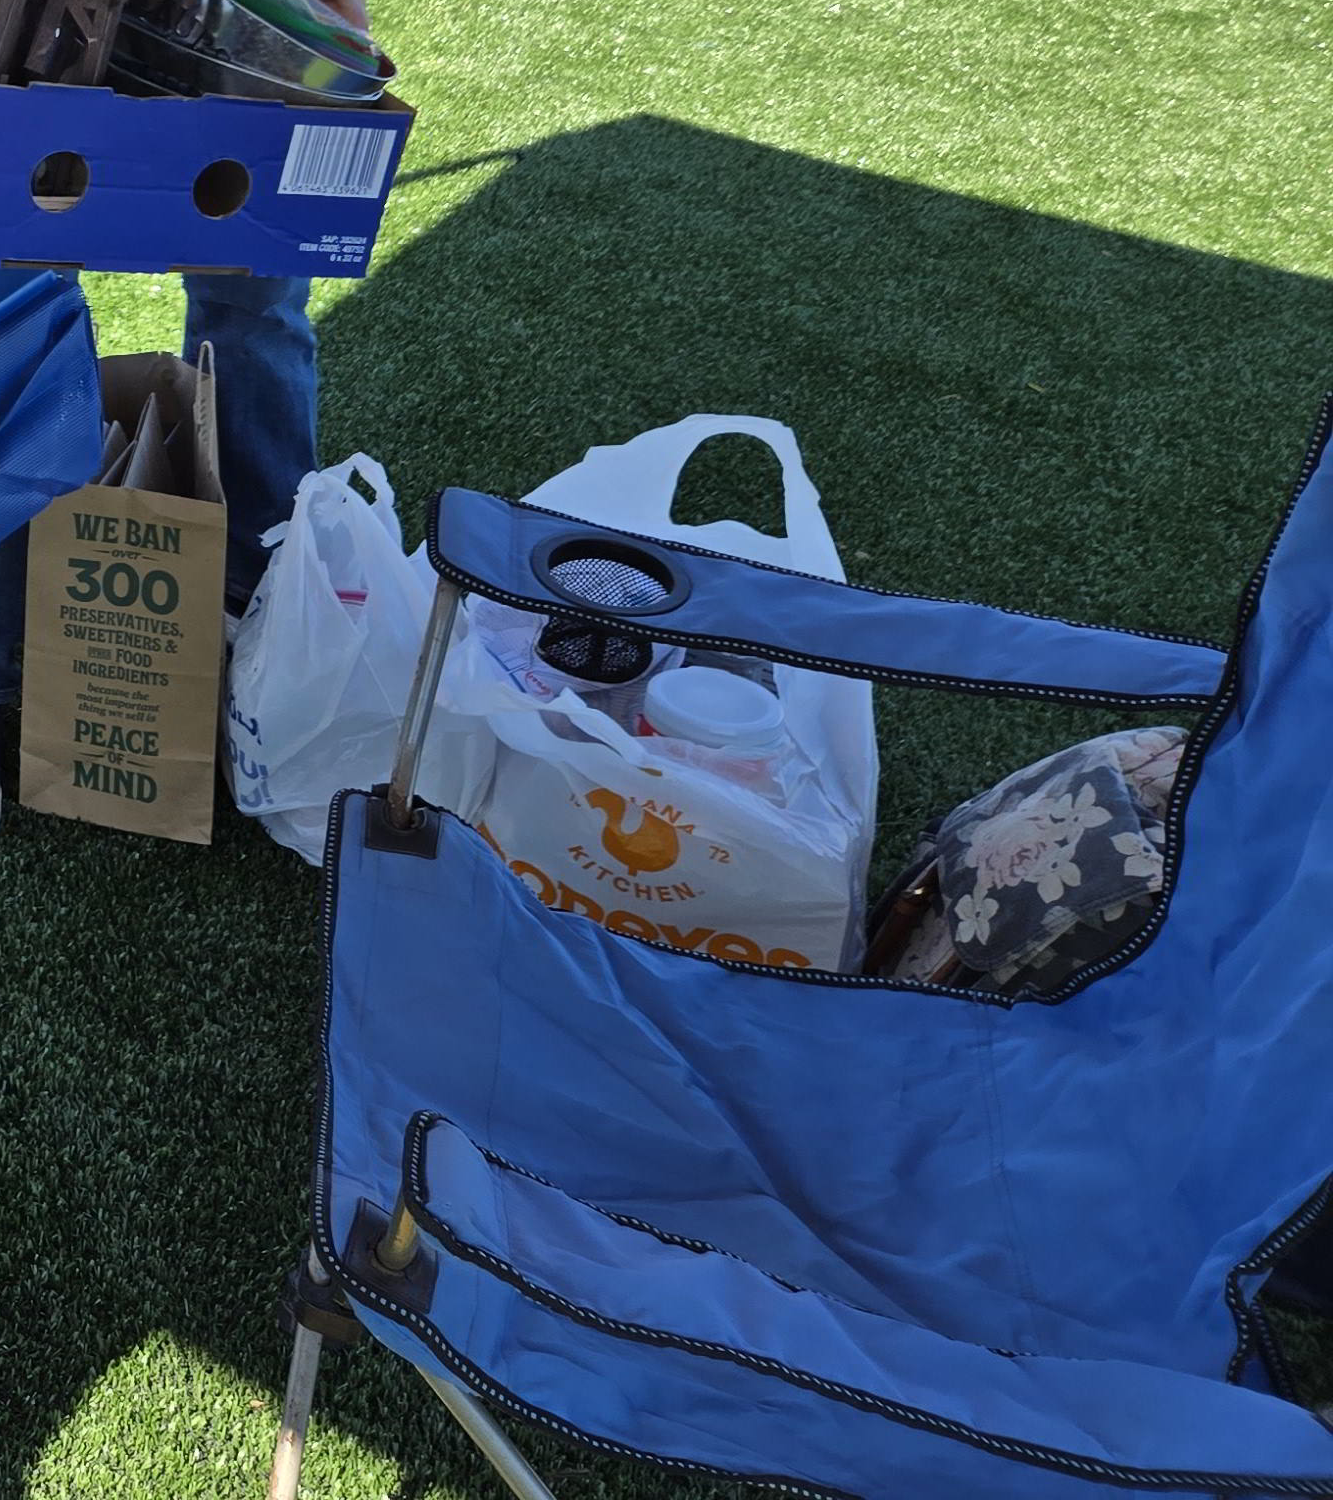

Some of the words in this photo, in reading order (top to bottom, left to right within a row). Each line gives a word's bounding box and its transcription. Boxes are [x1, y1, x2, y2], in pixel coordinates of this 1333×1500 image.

[72, 513, 119, 544] WE
[125, 518, 181, 555] BAN
[111, 549, 142, 560] over
[65, 558, 179, 615] 300
[60, 605, 184, 638] PRESERVATIVES,
[63, 624, 162, 652] SWEETENERS
[164, 639, 179, 654] &
[115, 648, 153, 668] FOOD
[72, 660, 169, 686] INGREDIENTS
[76, 693, 103, 704] most
[104, 696, 160, 713] important
[87, 682, 129, 699] because
[132, 690, 150, 701] the
[78, 702, 107, 717] thing
[108, 710, 124, 718] we
[125, 711, 145, 722] sell
[145, 712, 157, 723] is
[73, 719, 159, 757] PEACE
[107, 752, 125, 766] OF
[72, 760, 158, 804] MIND
[709, 844, 732, 864] 72
[568, 844, 696, 901] KITCHEN
